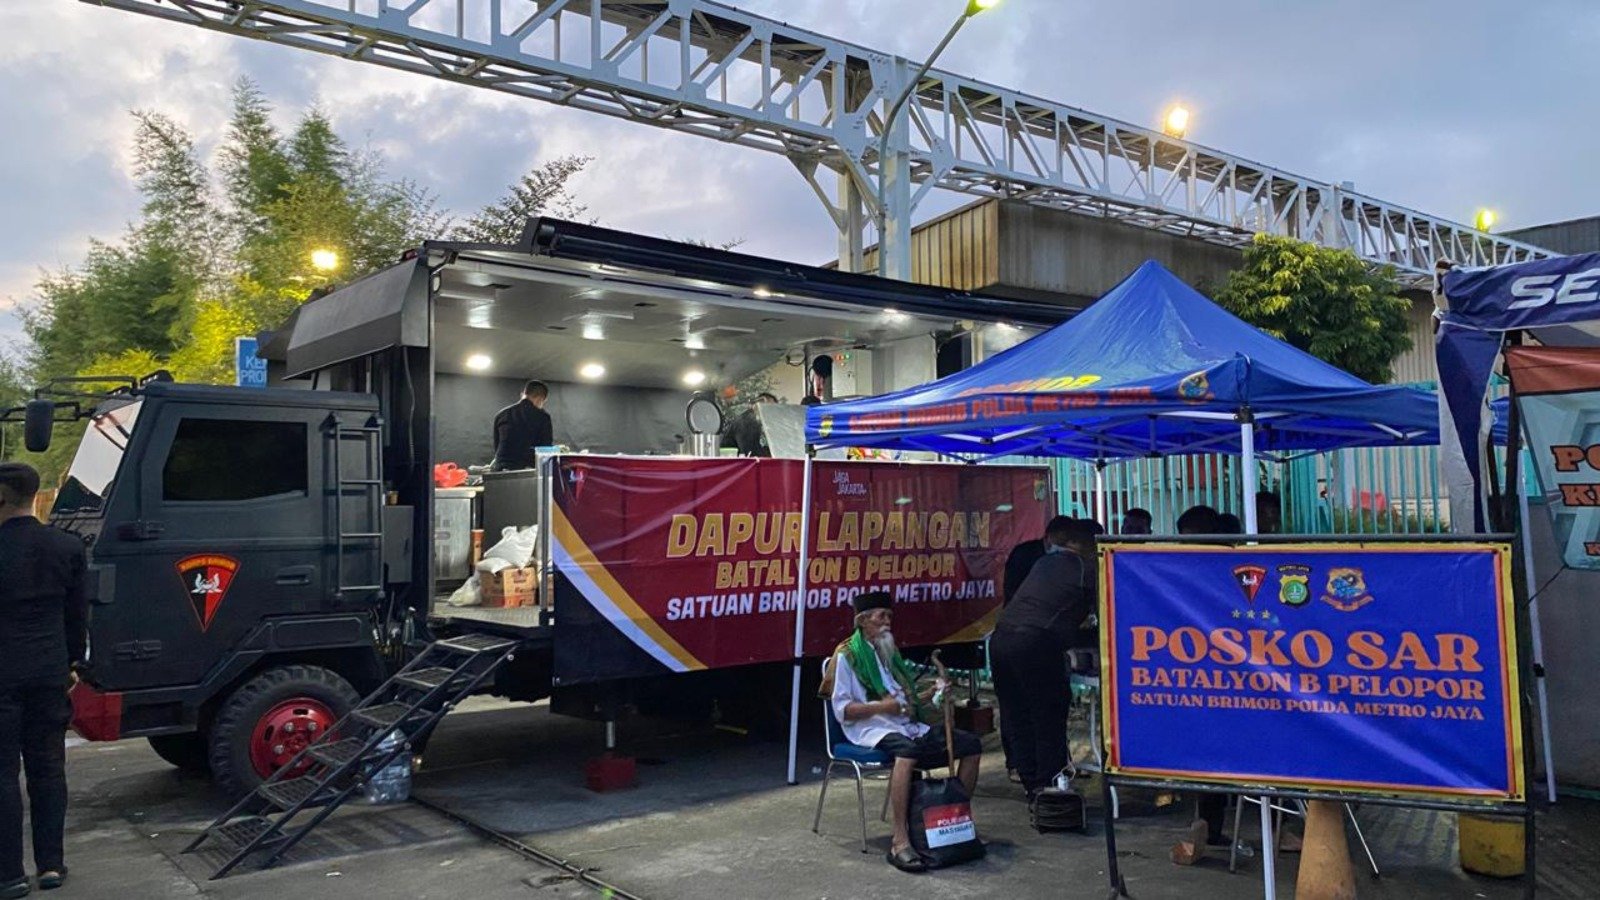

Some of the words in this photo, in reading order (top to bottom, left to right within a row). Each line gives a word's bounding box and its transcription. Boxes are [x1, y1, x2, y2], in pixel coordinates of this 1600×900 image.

[972, 396, 1027, 419] POLDA
[666, 512, 802, 558] DAPUR
[817, 511, 991, 551] LAPANGAN
[846, 556, 861, 582] B
[865, 553, 955, 581] PELOPOR
[666, 592, 754, 621] SATUAN
[895, 582, 952, 603] METRO
[955, 579, 995, 600] JAYA
[1130, 626, 1333, 669] POSKO
[1346, 631, 1485, 672] SAR
[1131, 667, 1292, 693] BATALYON
[1299, 673, 1321, 693] B
[1328, 674, 1486, 701] PELOPOR
[1131, 692, 1203, 707] SATUAN
[1207, 695, 1282, 711] BRIMOB
[1286, 699, 1350, 715] POLDA
[1354, 702, 1427, 718] METRO
[1430, 704, 1485, 721] JAYA
